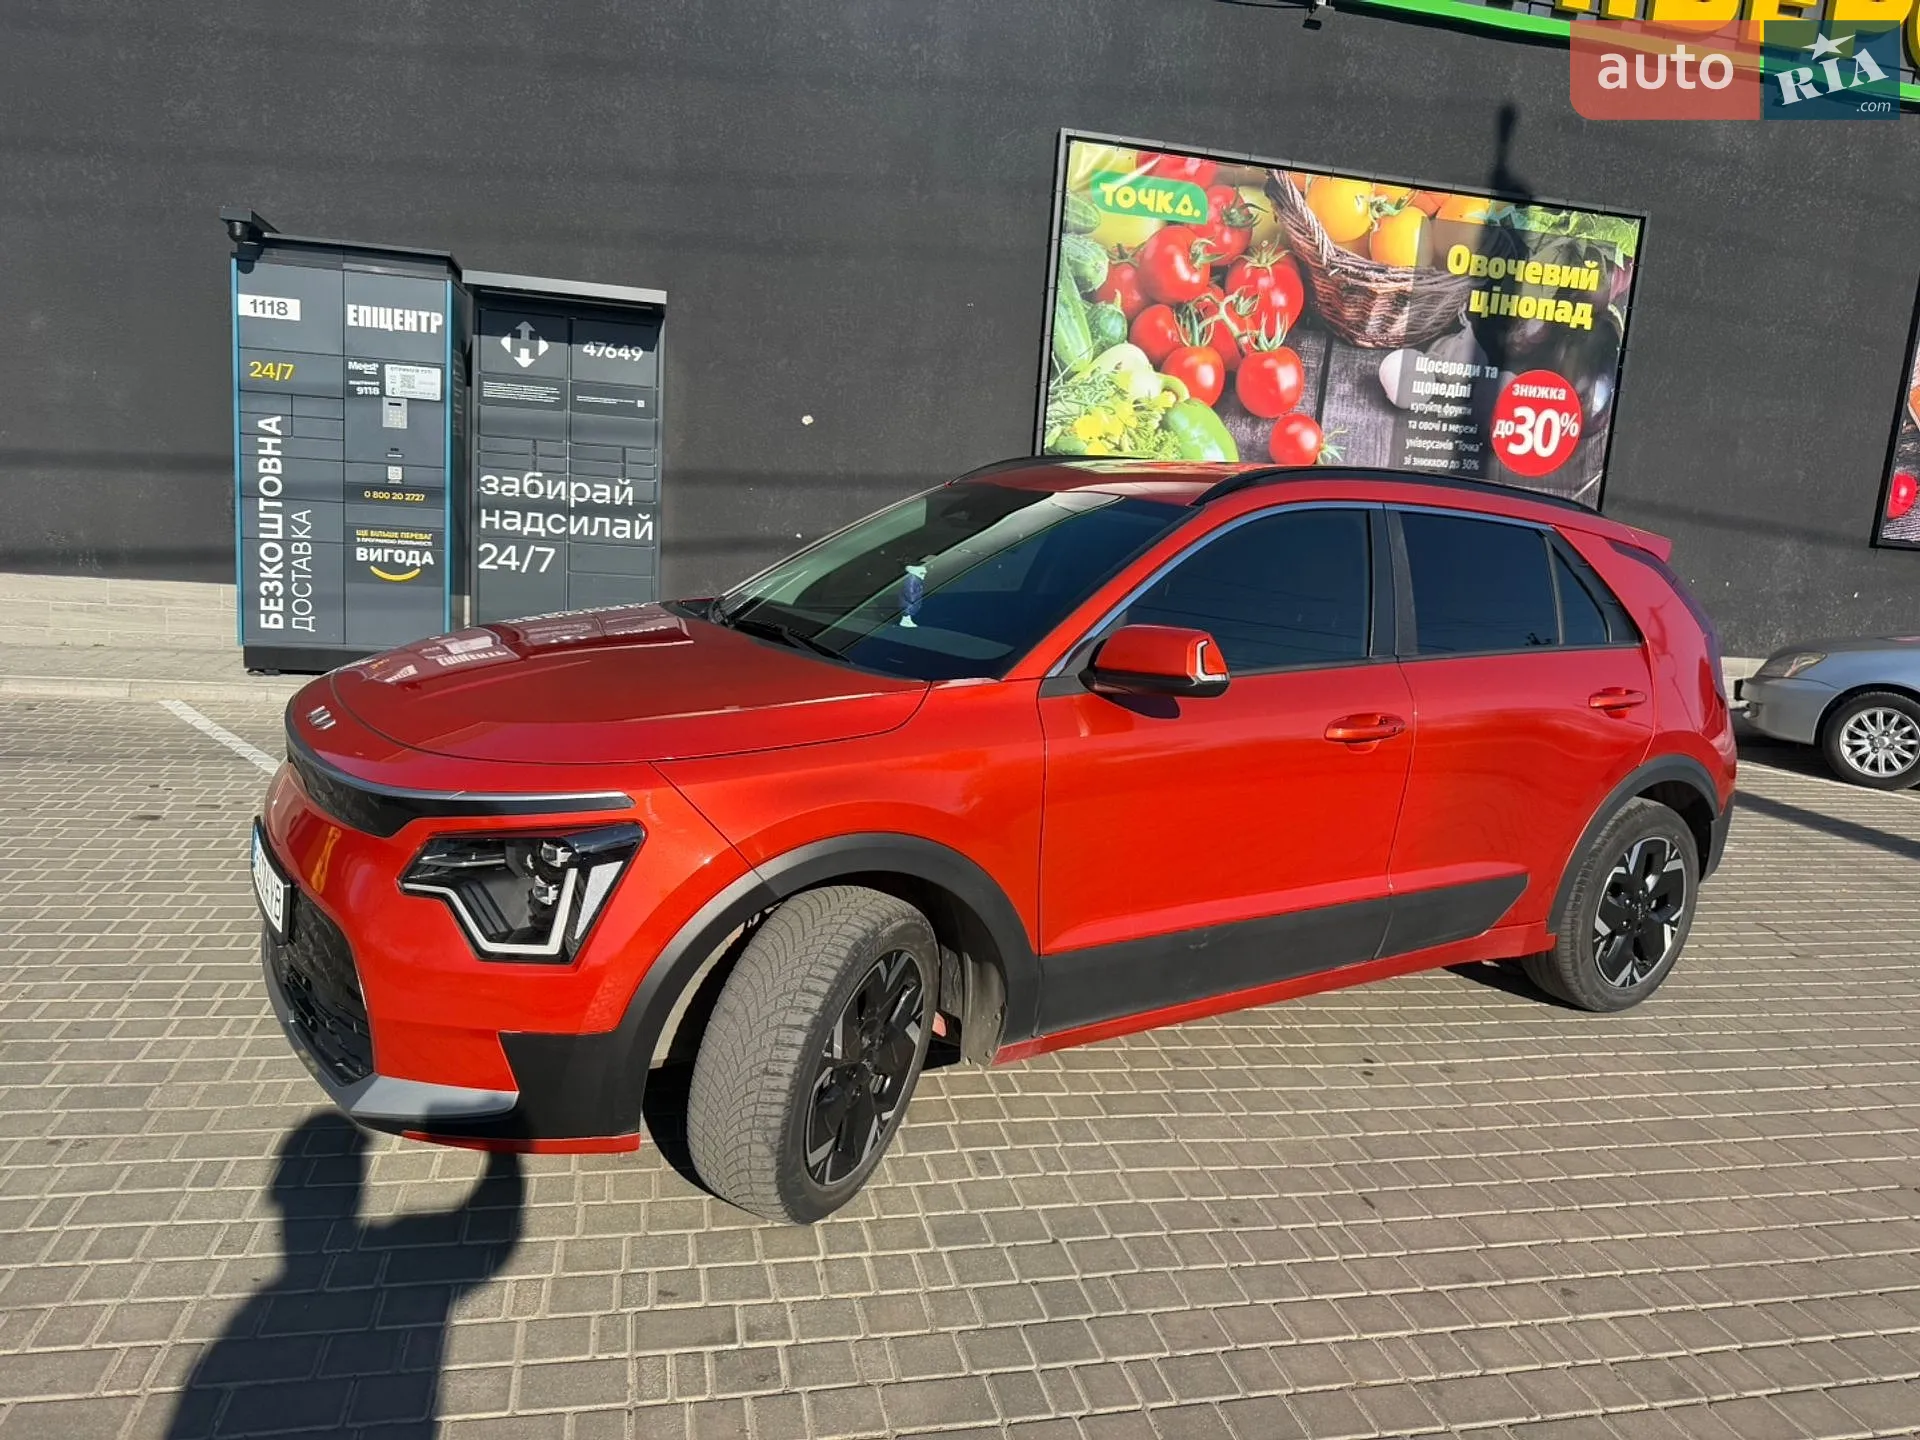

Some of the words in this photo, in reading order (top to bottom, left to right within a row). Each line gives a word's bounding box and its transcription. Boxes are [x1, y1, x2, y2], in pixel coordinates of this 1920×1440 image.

[1447, 244, 1599, 292] Овочевий
[250, 299, 288, 316] 1118
[347, 304, 443, 334] ЕПІЦЕНТР
[1468, 285, 1594, 330] цінопад
[582, 341, 643, 362] 47649
[249, 361, 295, 381] 24/7
[1415, 356, 1480, 378] Щосереди
[1484, 364, 1498, 379] та
[1412, 381, 1471, 398] щонеділі
[1512, 383, 1566, 400] знижка
[1408, 420, 1417, 429] та
[1418, 420, 1441, 431] овочі
[1493, 419, 1514, 439] до
[1507, 406, 1579, 458] 30%
[372, 491, 390, 499] 800
[479, 471, 634, 507] забирай
[257, 415, 284, 630] БЕЗКОШТОВНА
[480, 508, 654, 541] надсилай
[356, 547, 434, 566] ВИГОДА
[477, 542, 556, 573] 24/7
[291, 509, 316, 633] ДОСТАВКА
